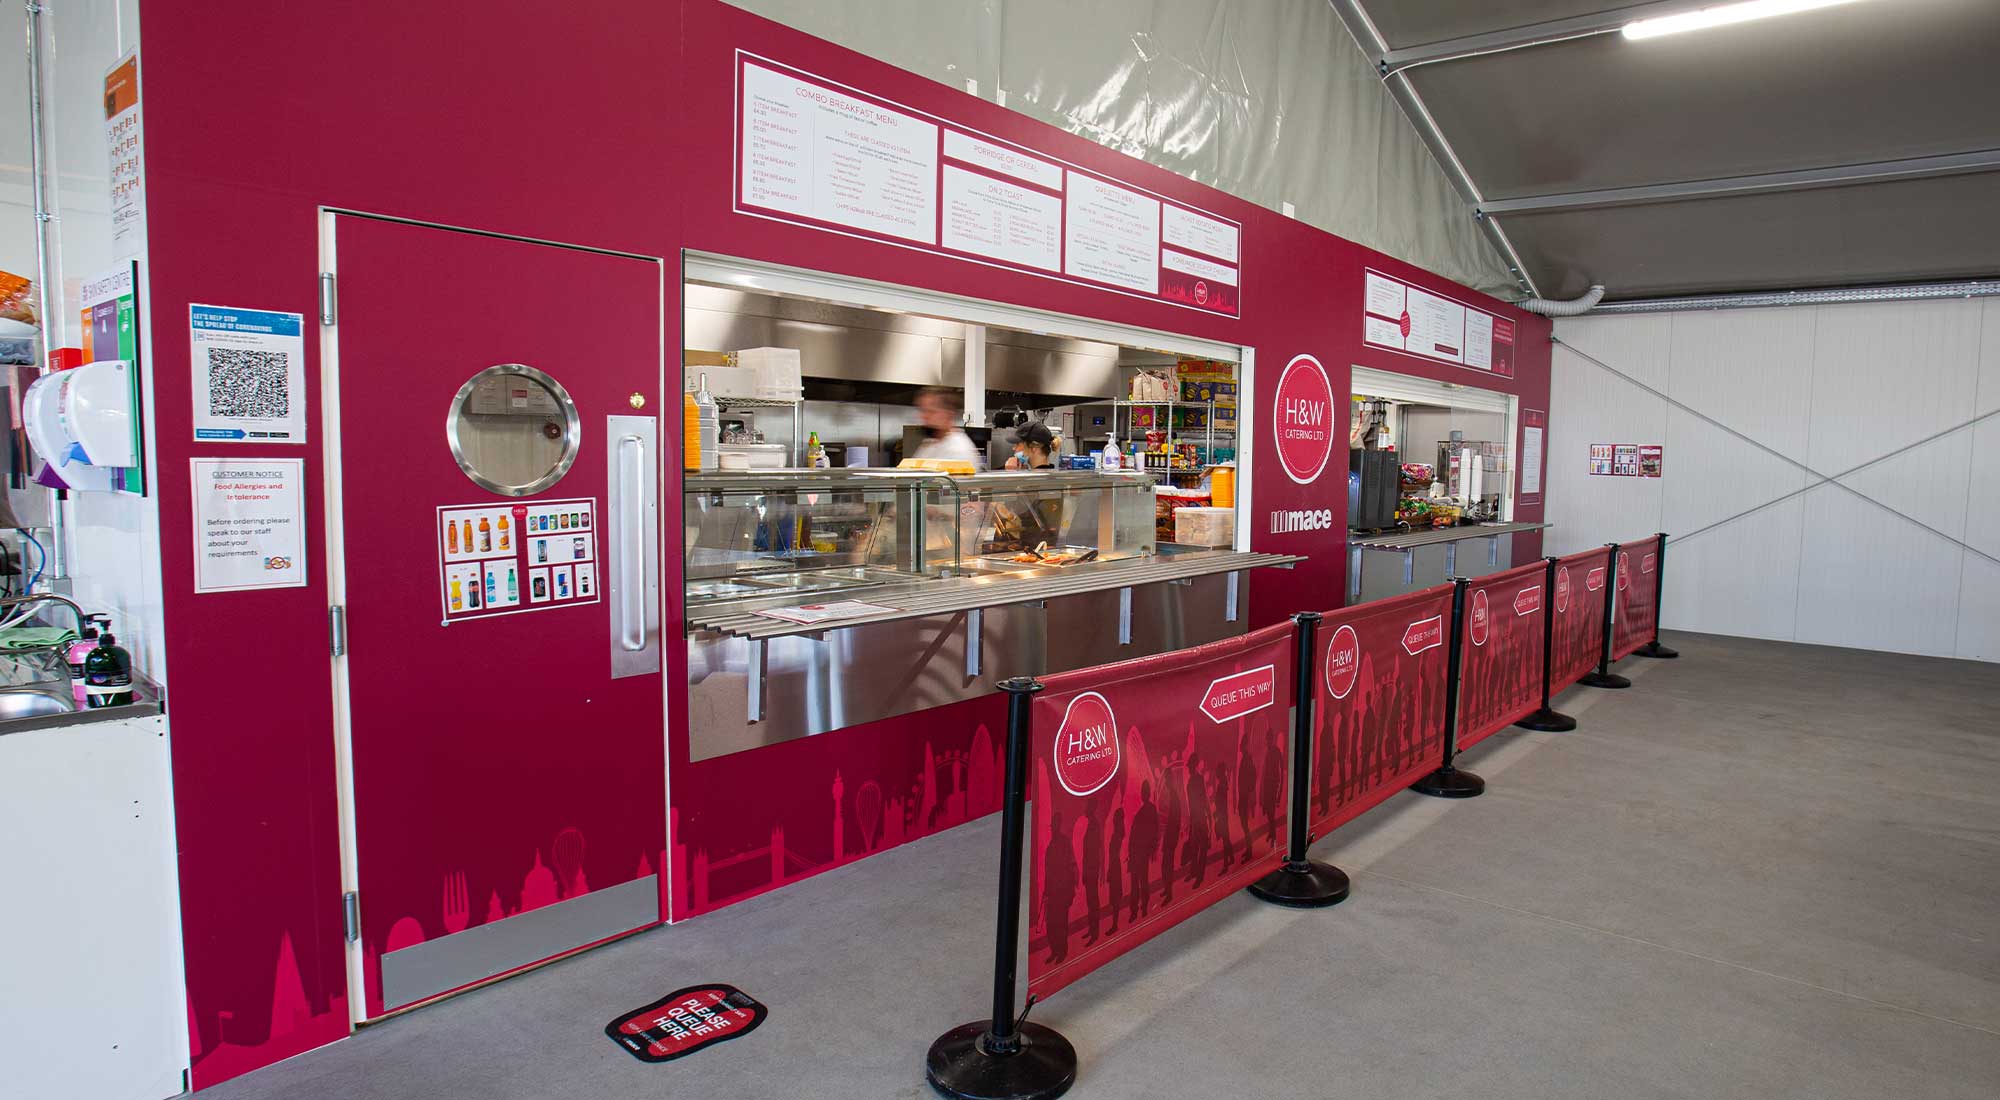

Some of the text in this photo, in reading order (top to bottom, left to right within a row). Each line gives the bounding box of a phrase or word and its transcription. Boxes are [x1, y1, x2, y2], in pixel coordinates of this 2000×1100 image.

[795, 87, 898, 127] COMBO BREAKFAST MENU
[973, 145, 1005, 162] PORRIDGE
[1005, 189, 1024, 201] TOAST
[1285, 398, 1325, 426] H&W
[1285, 429, 1324, 441] CATERING LTD
[212, 471, 284, 479] CUSTOMER NOTICE
[234, 483, 267, 491] Allergies
[207, 517, 290, 526] Before ordering please
[208, 550, 258, 558] requirements
[1407, 633, 1423, 645] QUEUE
[1331, 647, 1354, 669] H&W
[1210, 681, 1272, 709] QUEUE THIS WAY
[1067, 722, 1107, 755] H&W
[1066, 747, 1113, 766] CATERING LTD
[667, 1007, 713, 1037] QUEUE
[681, 998, 732, 1030] PLEASE
[652, 1016, 692, 1041] HERE
